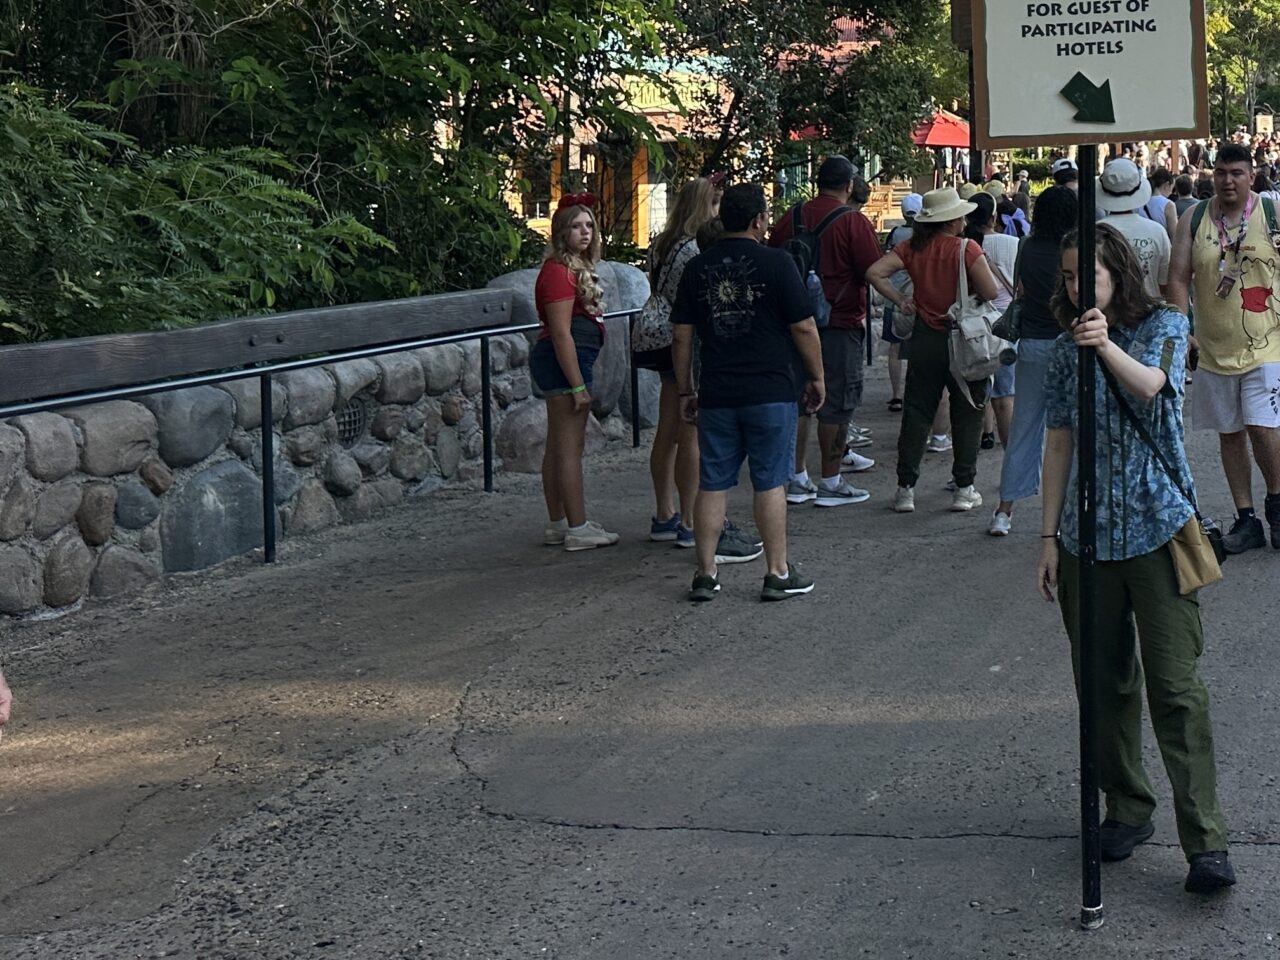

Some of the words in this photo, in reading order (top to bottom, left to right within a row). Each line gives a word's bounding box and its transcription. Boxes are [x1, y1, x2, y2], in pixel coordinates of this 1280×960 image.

[1027, 3, 1062, 17] FOR
[1067, 0, 1121, 15] GUEST
[1126, 0, 1149, 12] OF
[1021, 19, 1157, 38] PARTICIPATING
[1056, 41, 1124, 56] HOTELS
